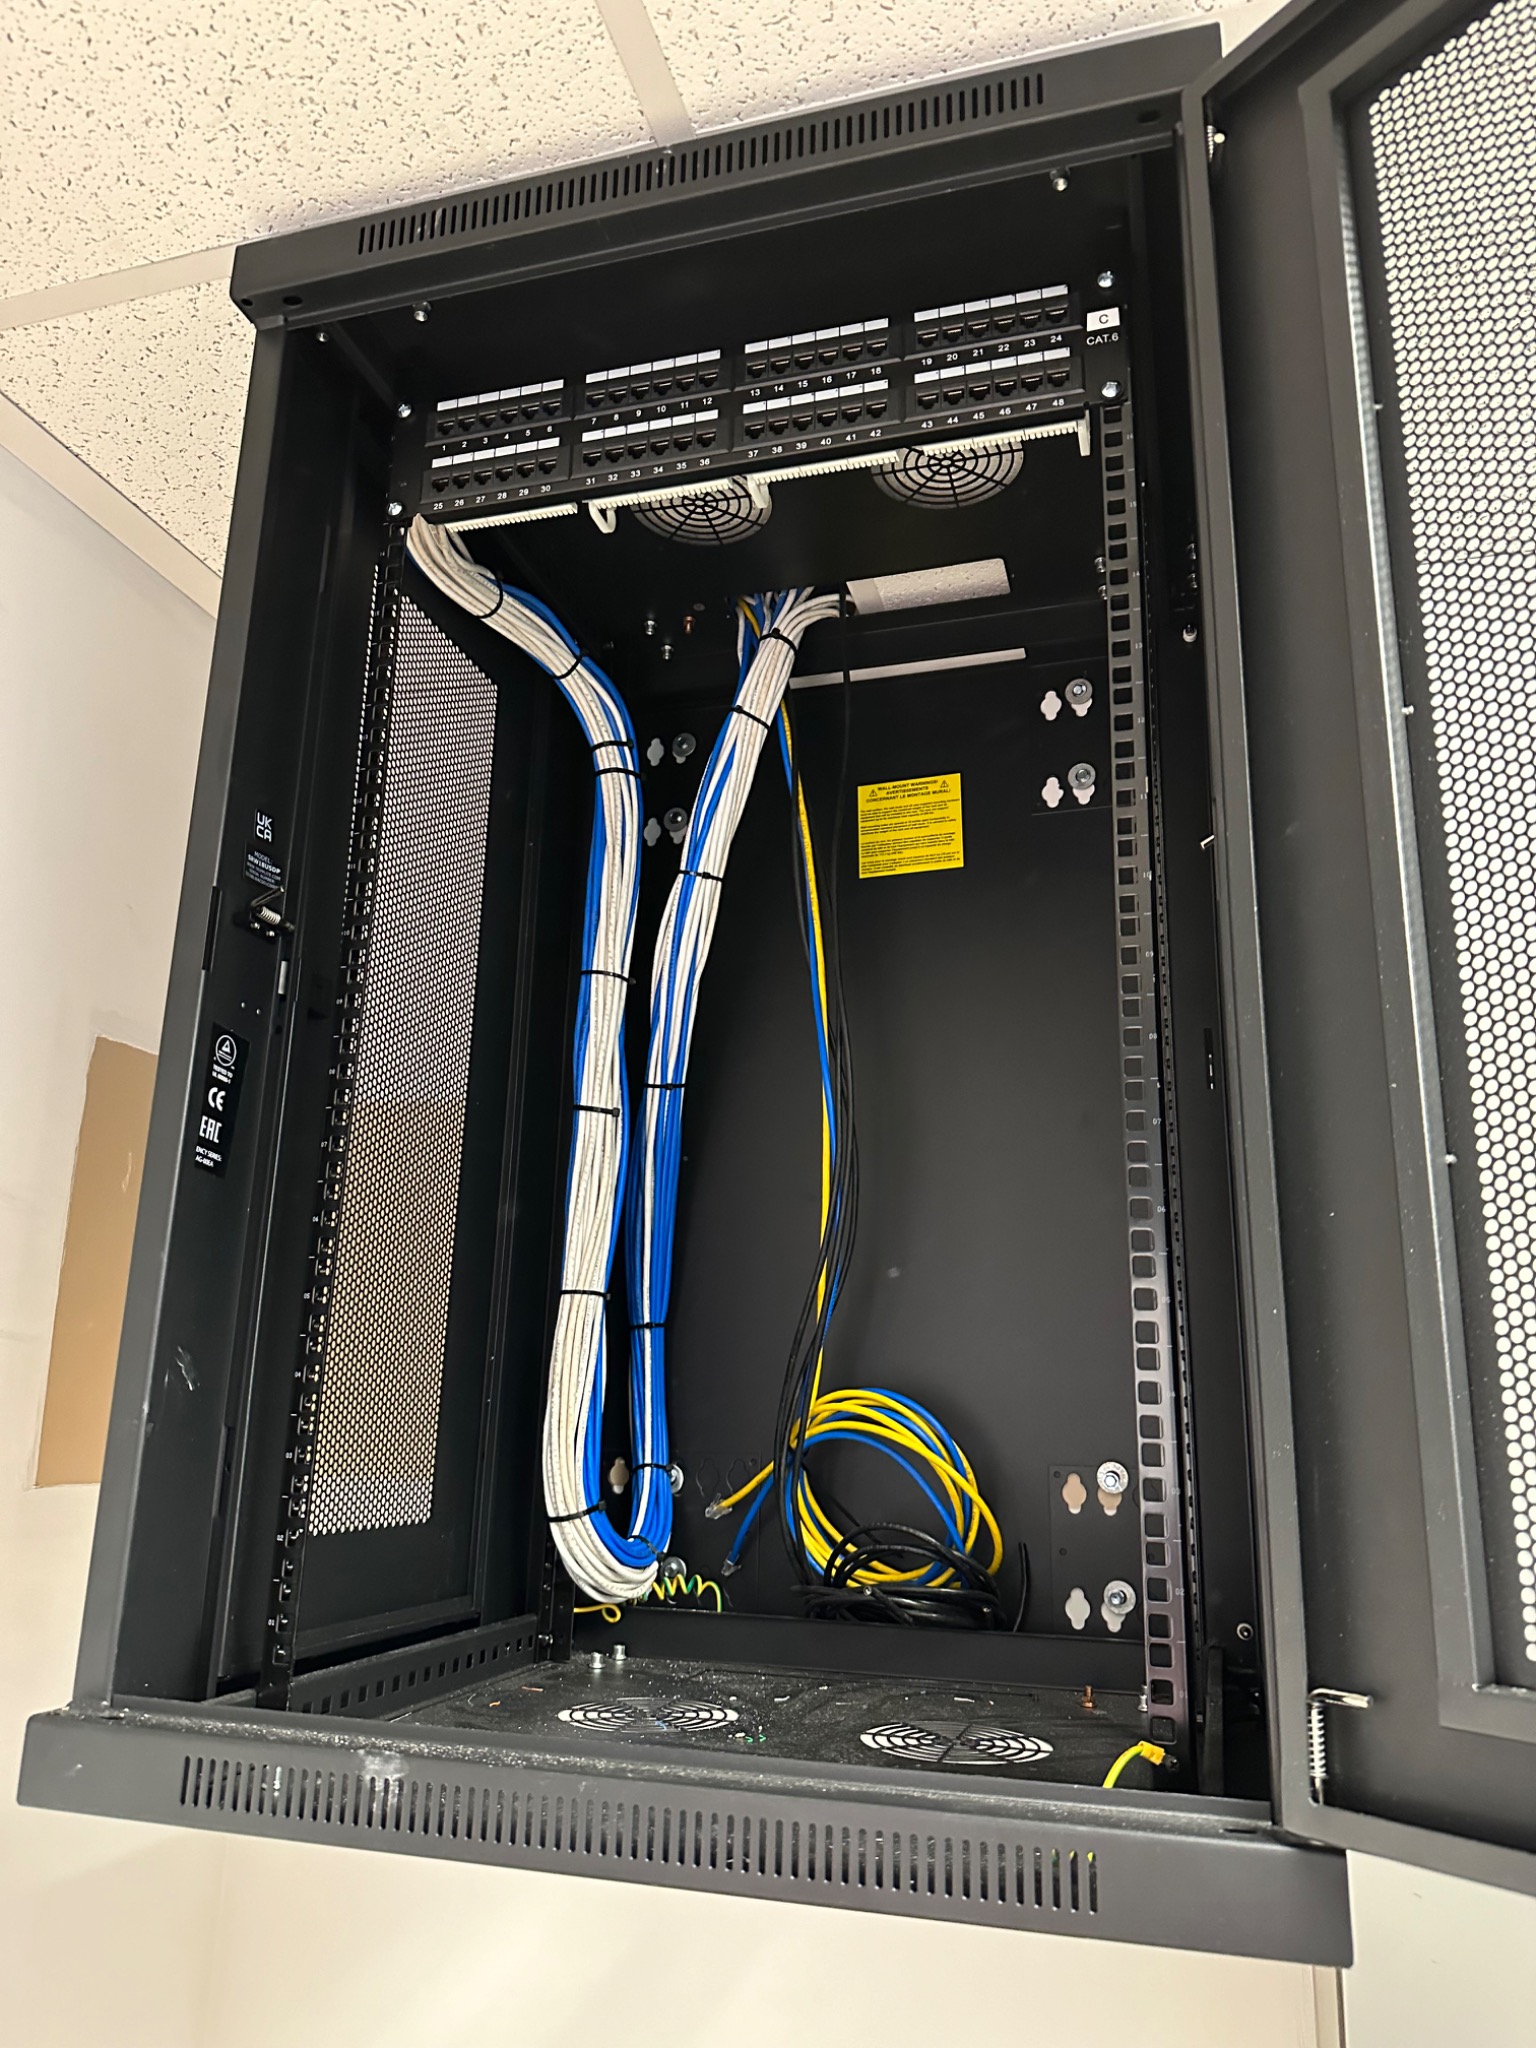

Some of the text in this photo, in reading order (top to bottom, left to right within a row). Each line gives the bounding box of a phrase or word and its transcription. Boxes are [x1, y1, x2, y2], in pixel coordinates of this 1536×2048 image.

[1098, 314, 1109, 324] C
[1086, 332, 1119, 346] CAT.6
[656, 404, 667, 414] 10
[680, 400, 688, 410] 11
[702, 396, 713, 406] 12
[750, 388, 761, 396] 13
[773, 384, 784, 392] 14
[798, 380, 808, 388] 15
[822, 376, 832, 384] 16
[846, 372, 857, 380] 17
[870, 366, 882, 376] 18
[922, 358, 932, 366] 19
[946, 352, 958, 362] 20
[972, 348, 984, 356] 21
[998, 344, 1010, 352] 22
[1024, 338, 1036, 348] 23
[1050, 334, 1062, 344] 24
[432, 397, 1064, 510] 25 26 27 28 29 30 31 32 33 34 35 36 37 38 39 40 41 42 43 44 45 46 47 48
[877, 782, 910, 792] WALL-MOUNT
[886, 786, 929, 796] AVERTISSEMENTS
[866, 796, 899, 804] CONCERNANT
[907, 790, 931, 798] MONTAGE
[256, 812, 273, 830] UK
[256, 824, 272, 843] CA
[208, 1086, 226, 1112] CE
[198, 1115, 222, 1143] EAC
